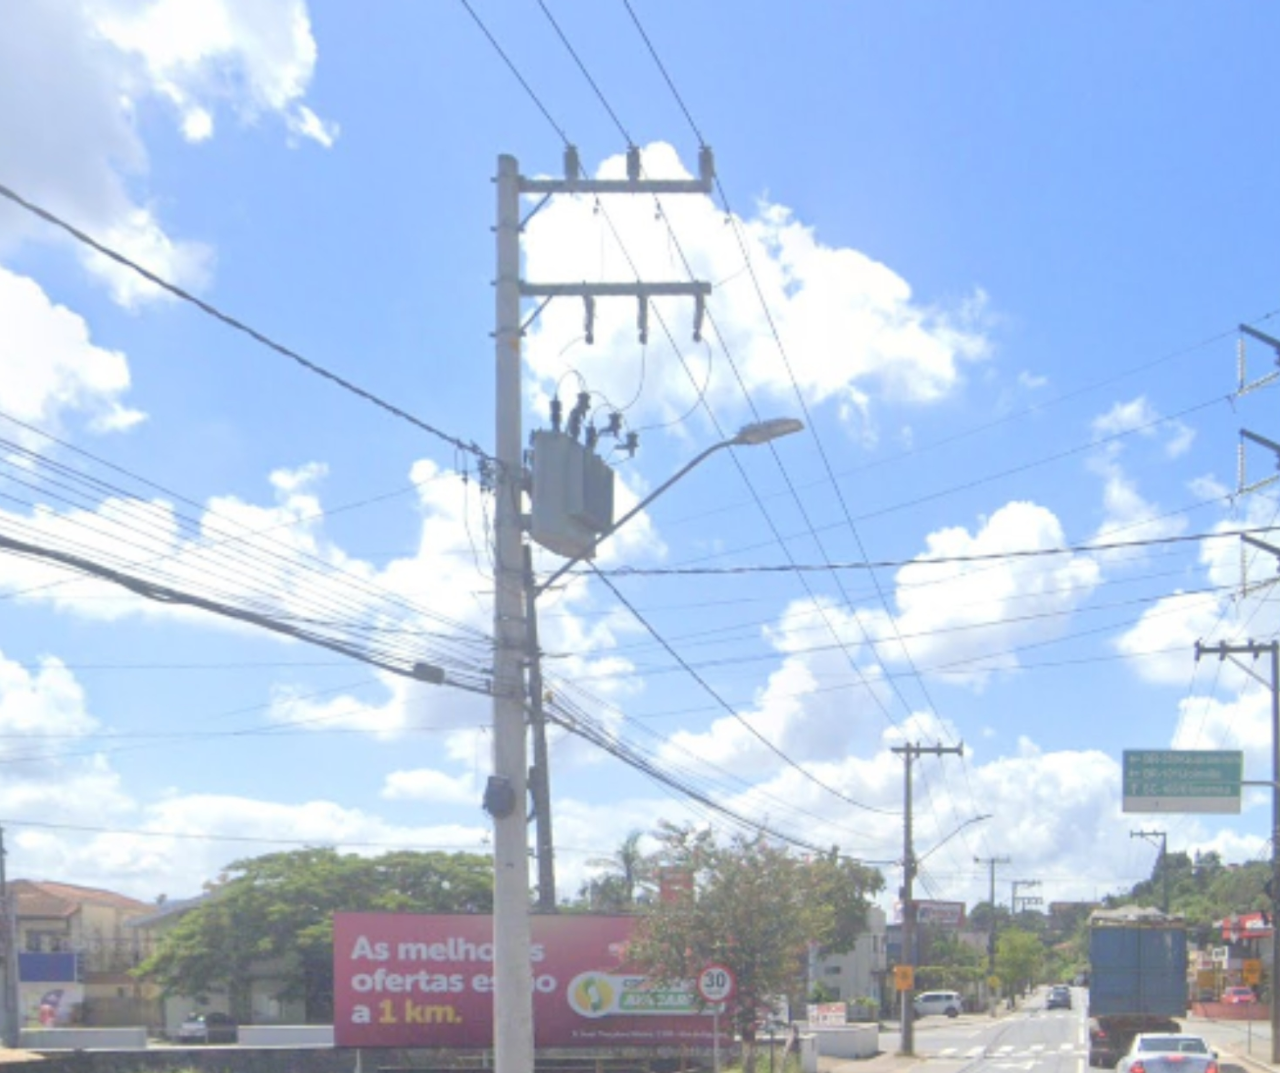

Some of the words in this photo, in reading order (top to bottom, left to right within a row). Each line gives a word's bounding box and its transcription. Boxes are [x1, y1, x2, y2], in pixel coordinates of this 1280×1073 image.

[351, 936, 390, 961] As
[398, 937, 545, 962] melhos
[351, 968, 464, 993] ofertas
[705, 971, 726, 988] 30
[351, 1005, 370, 1024] a
[379, 999, 397, 1024] 1
[405, 999, 462, 1024] km.
